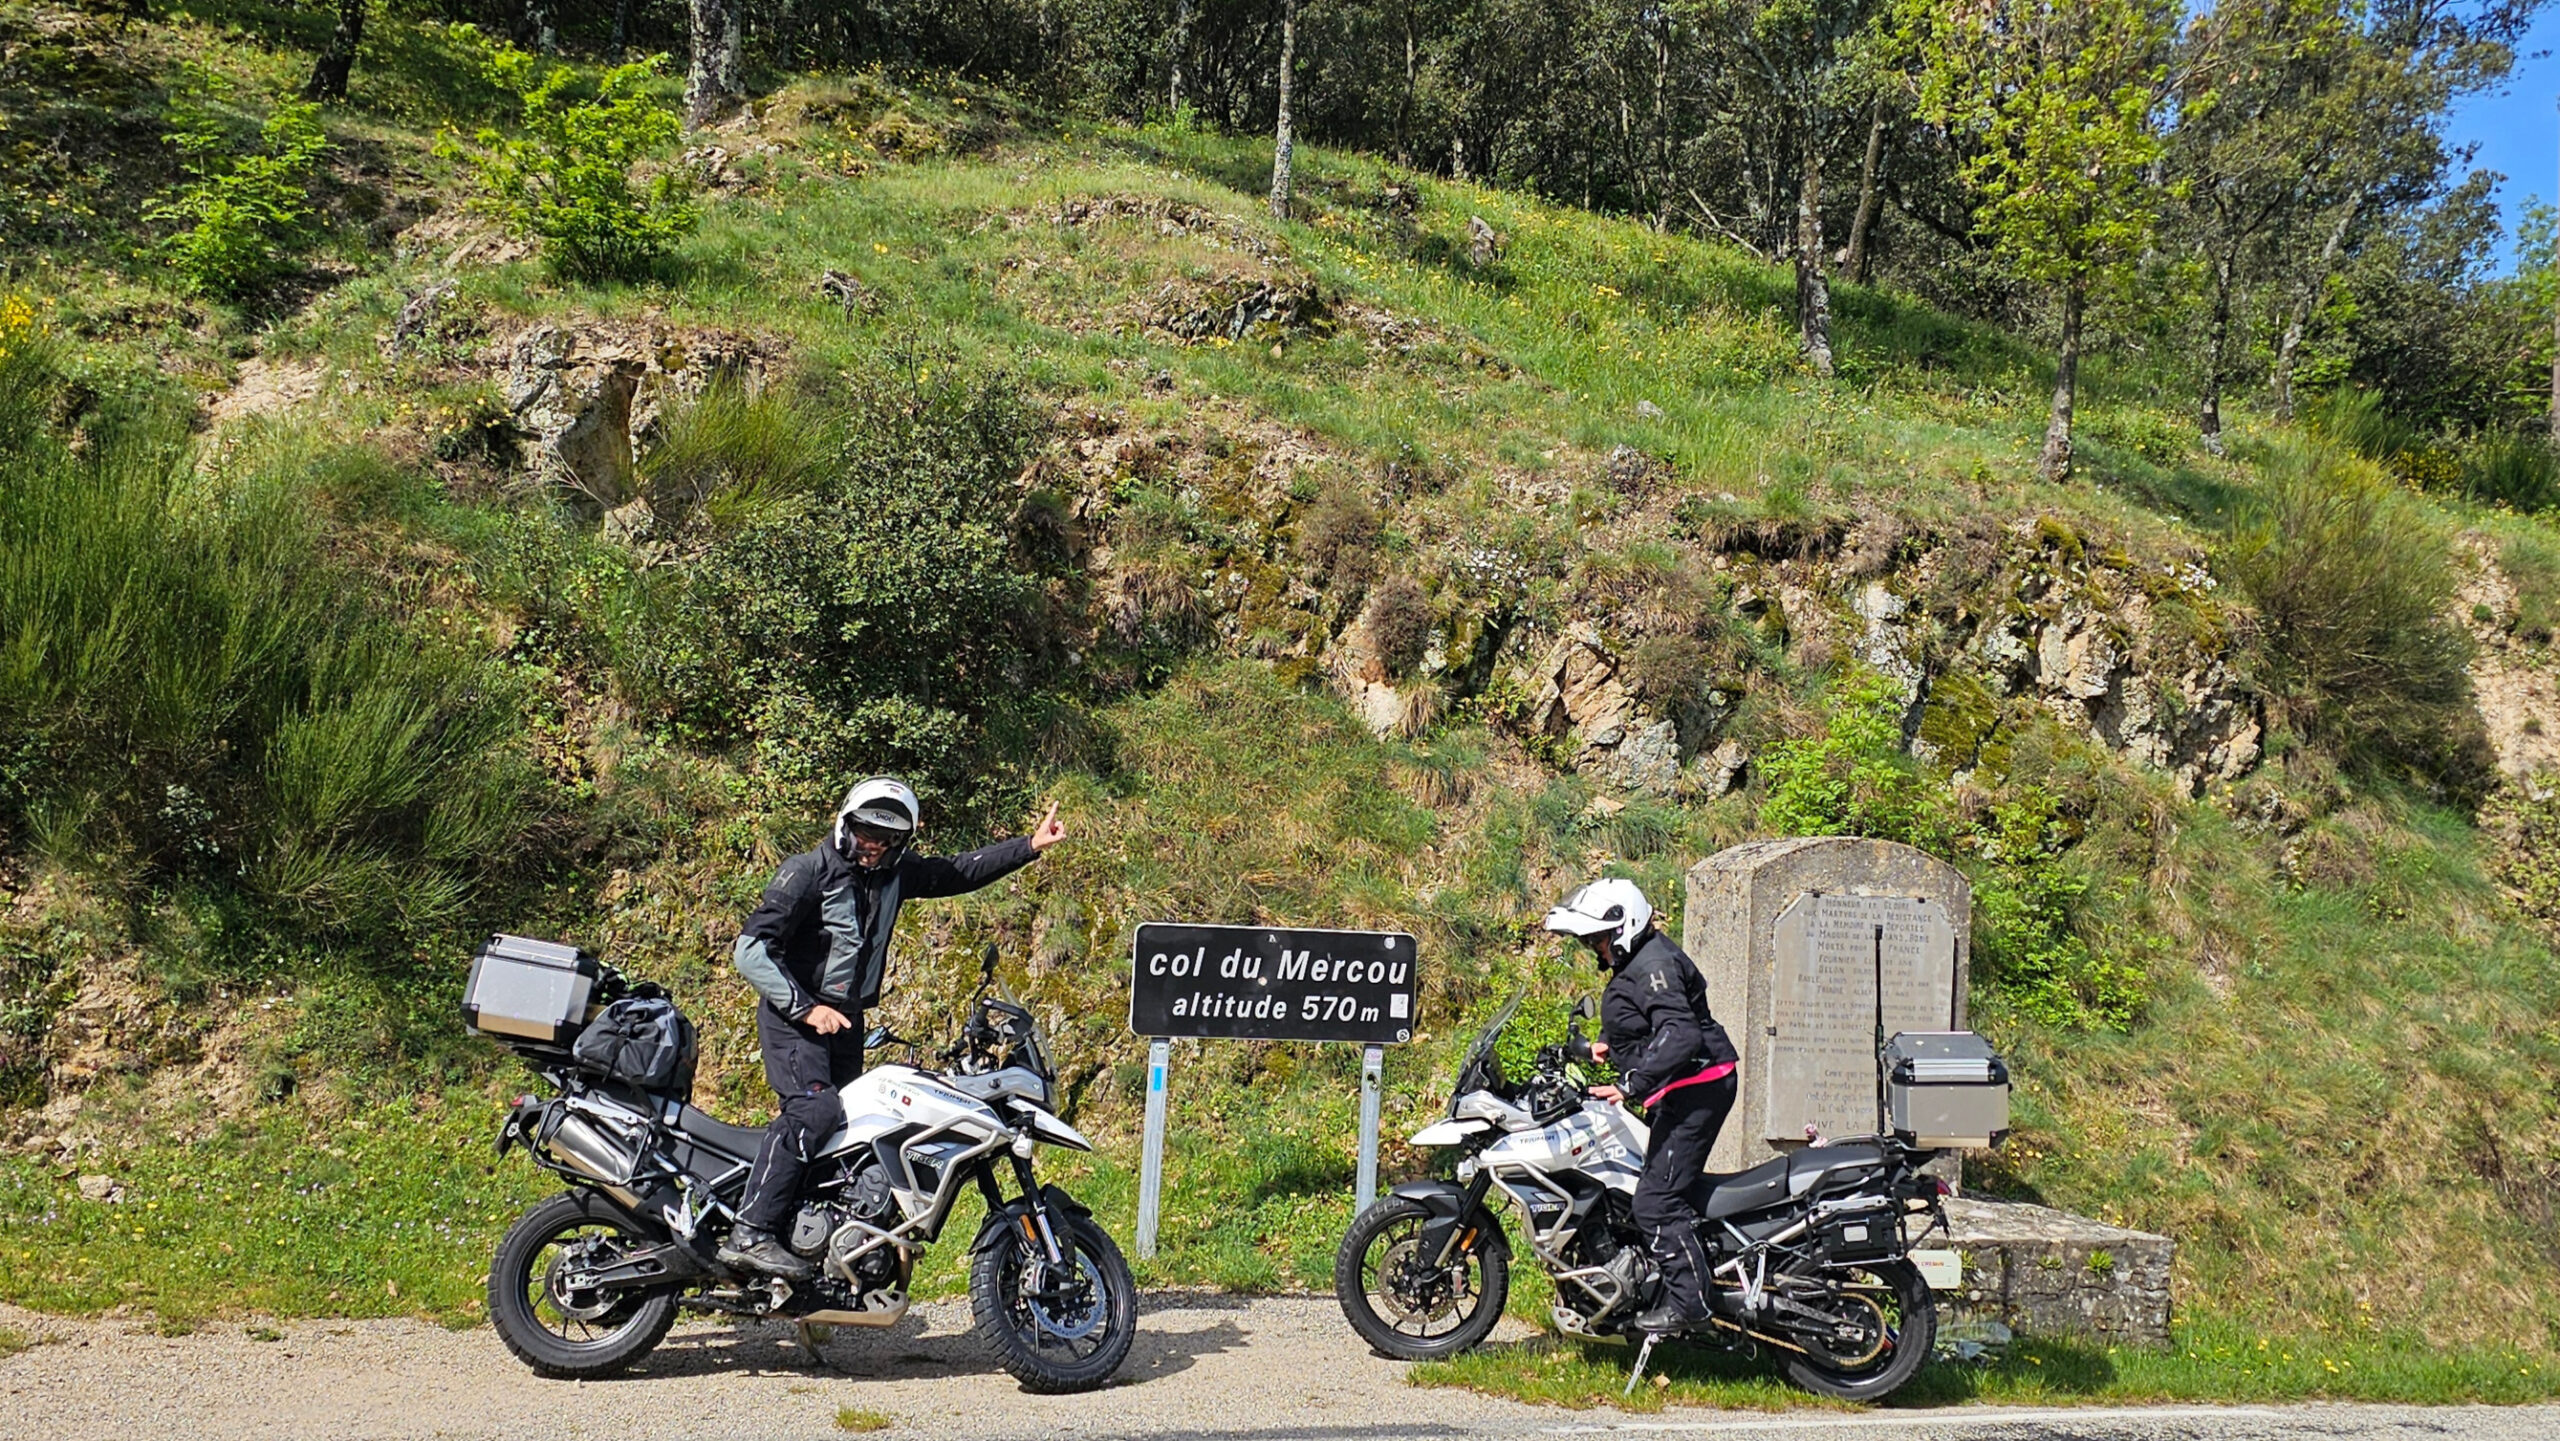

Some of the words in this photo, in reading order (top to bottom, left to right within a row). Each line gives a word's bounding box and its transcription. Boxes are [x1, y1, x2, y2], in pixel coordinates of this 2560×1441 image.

[1149, 946, 1205, 977] col
[1220, 947, 1262, 979] du
[1277, 950, 1408, 985] Mercou
[1172, 992, 1287, 1019] altitude
[905, 1150, 944, 1170] TIGER
[1530, 1202, 1567, 1213] TIGER
